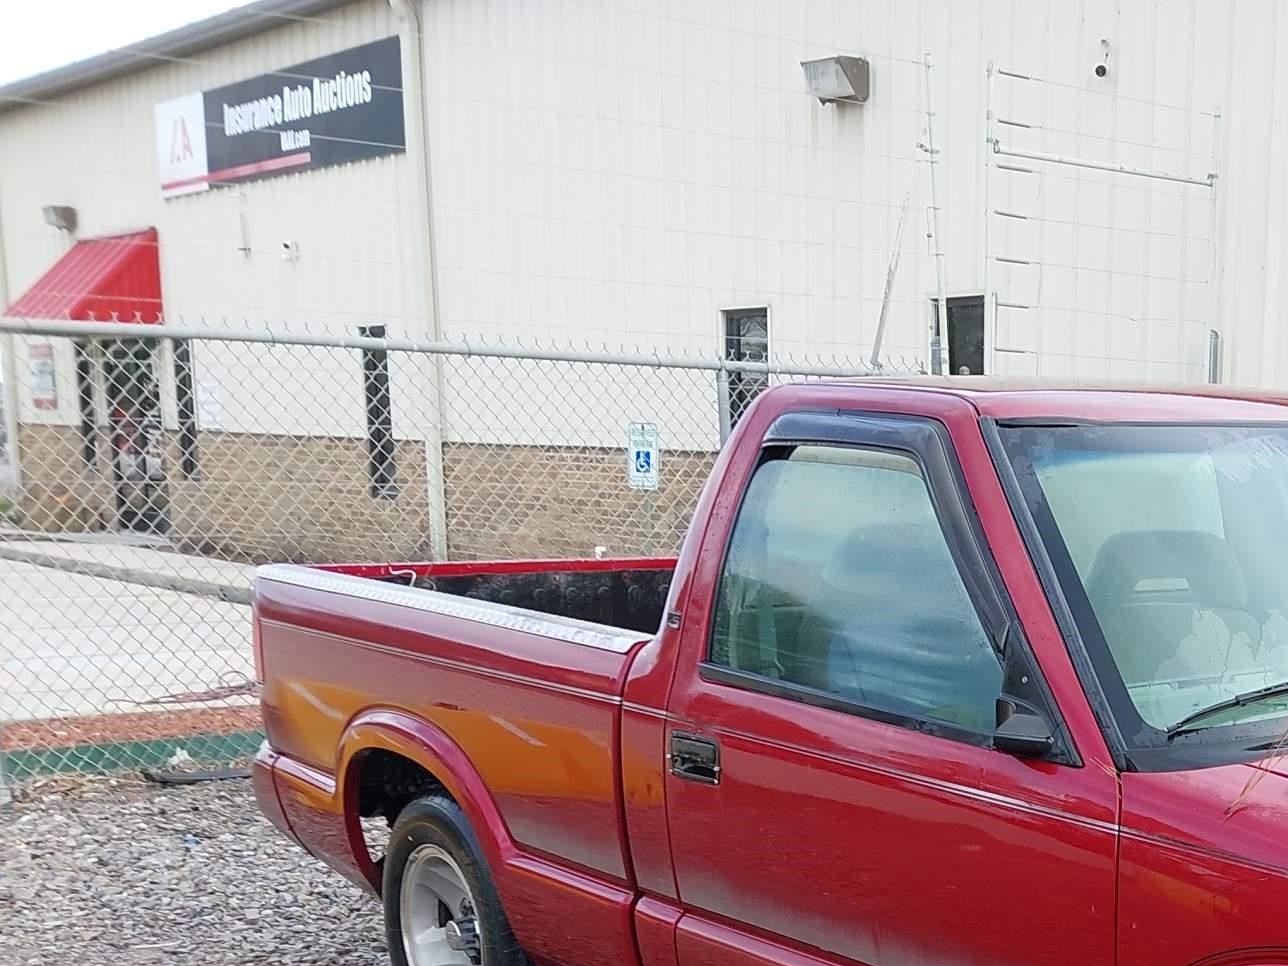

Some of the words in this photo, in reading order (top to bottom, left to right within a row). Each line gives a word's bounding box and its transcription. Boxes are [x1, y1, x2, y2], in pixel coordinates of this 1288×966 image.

[222, 94, 283, 137] Insurance
[282, 85, 312, 122] Auto
[312, 70, 372, 115] Auctions
